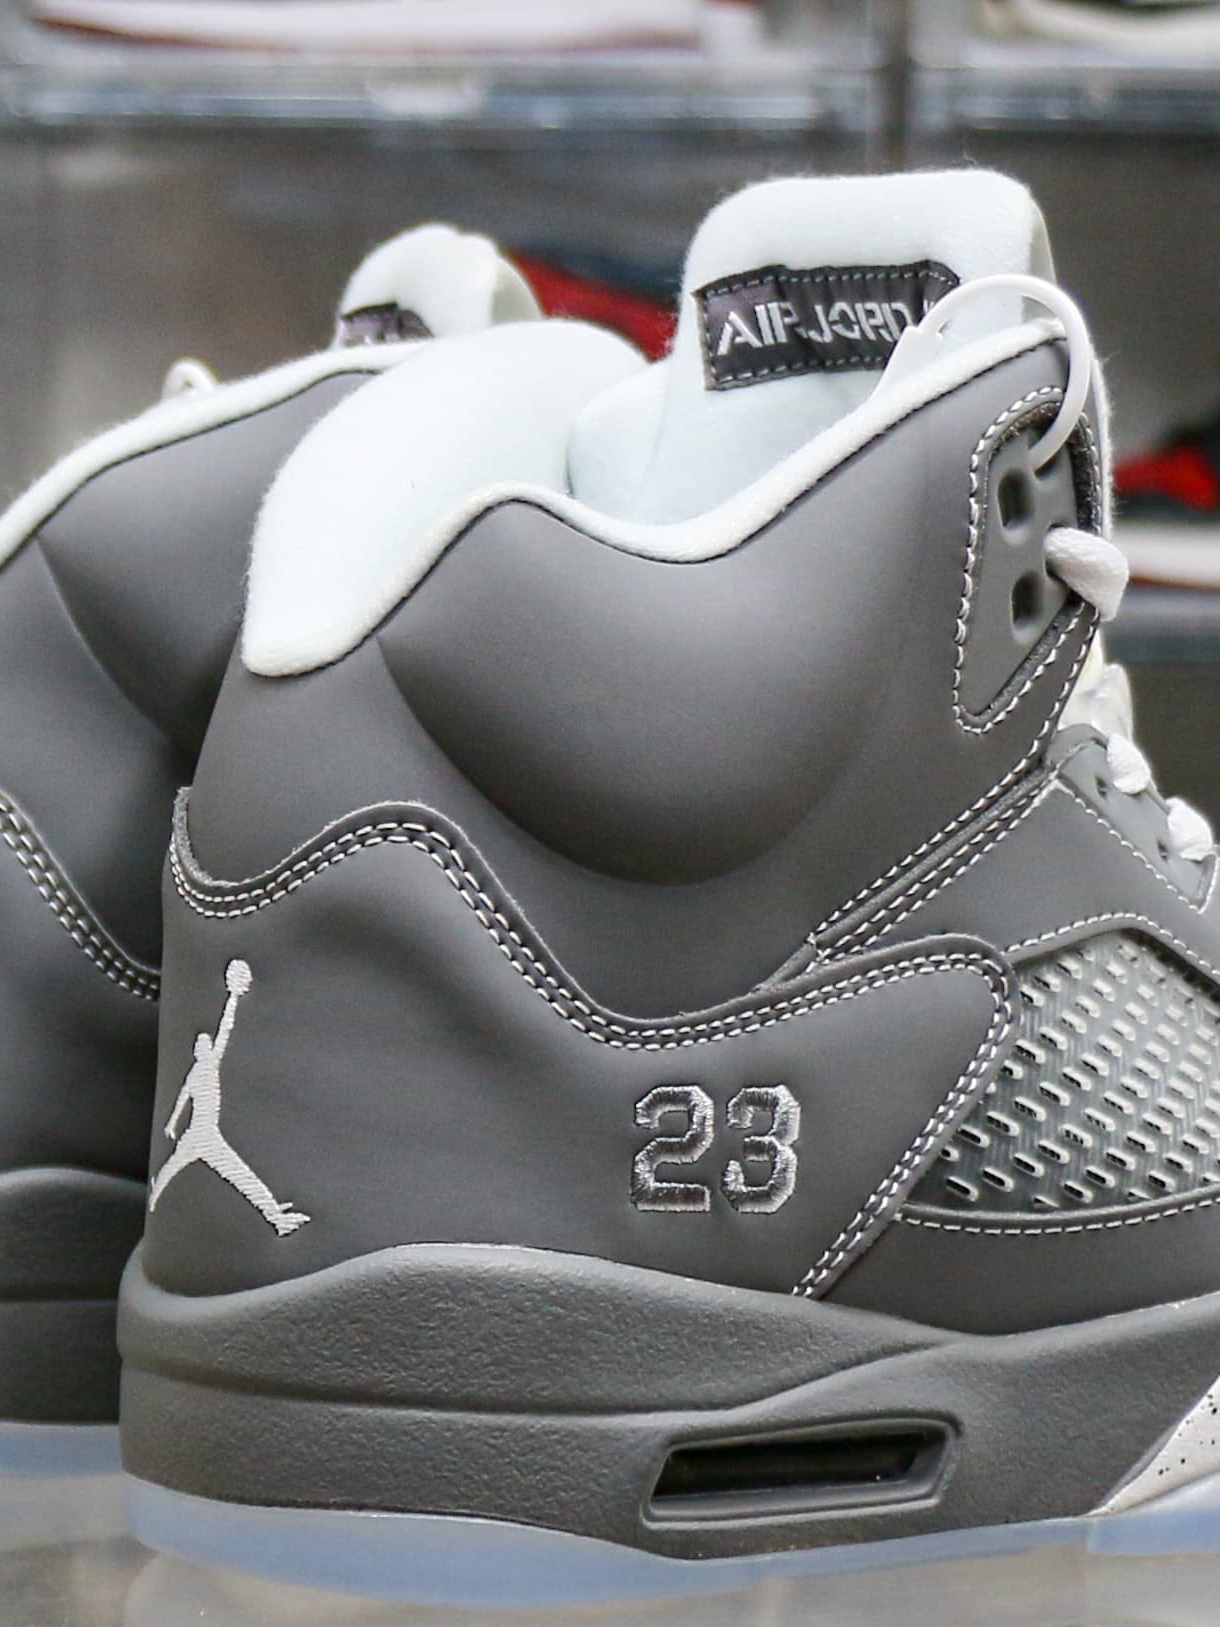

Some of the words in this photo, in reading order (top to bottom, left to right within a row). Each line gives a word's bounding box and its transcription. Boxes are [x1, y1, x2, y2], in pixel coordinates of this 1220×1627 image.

[717, 301, 808, 356] AIR
[807, 299, 936, 343] JORD
[631, 1084, 802, 1213] 23
